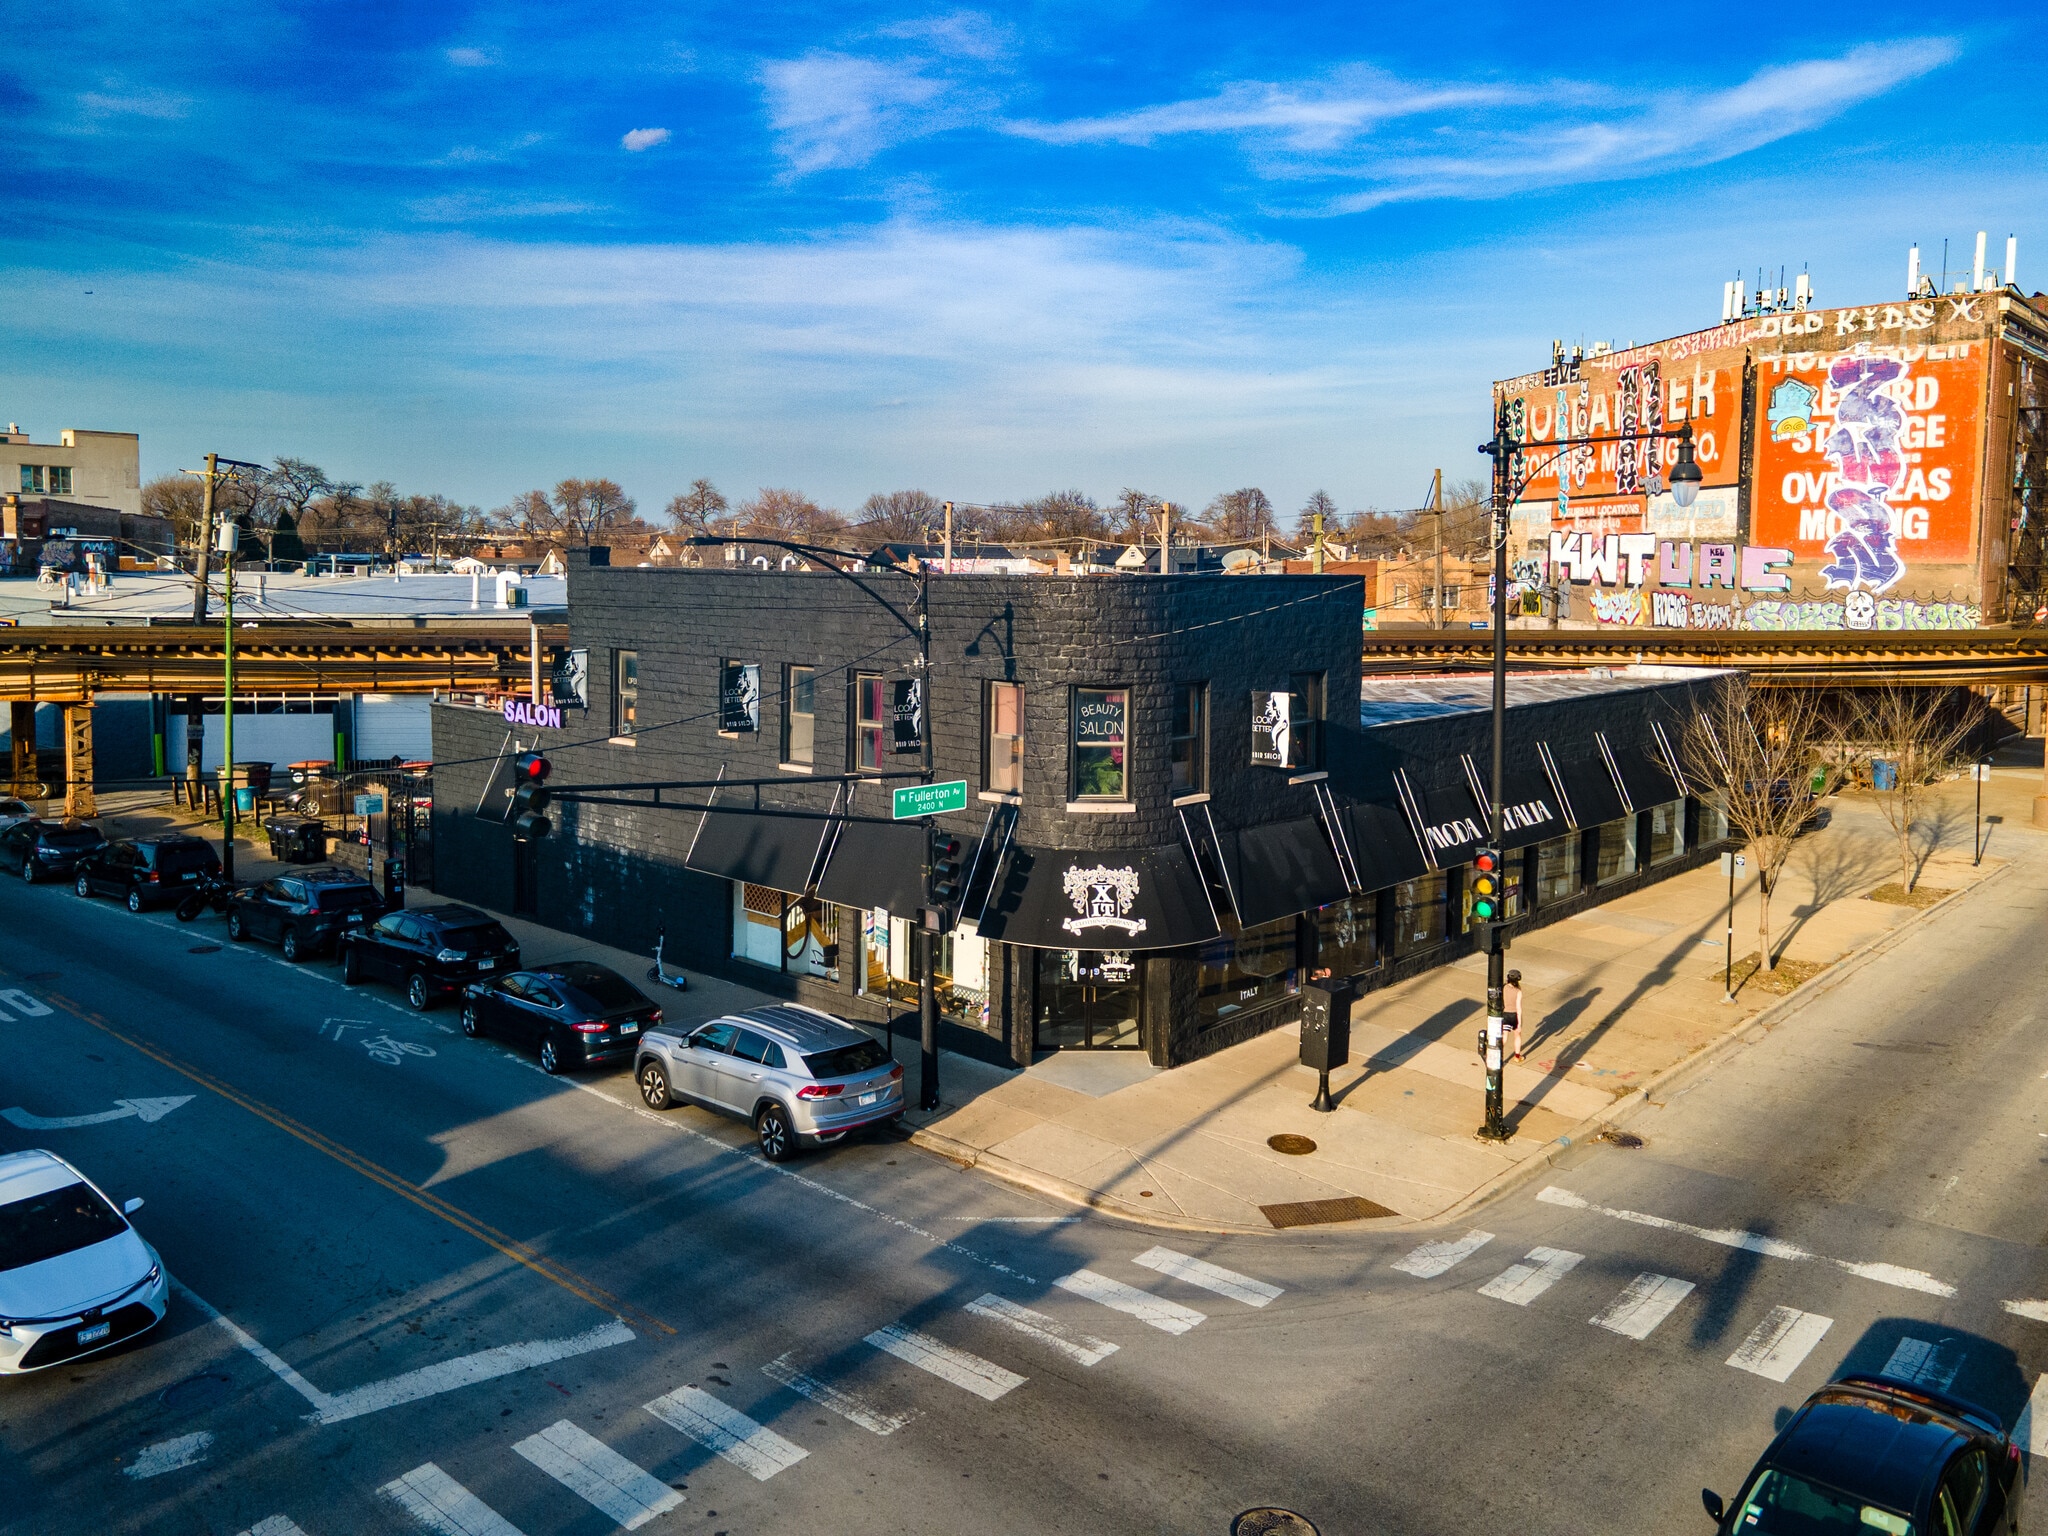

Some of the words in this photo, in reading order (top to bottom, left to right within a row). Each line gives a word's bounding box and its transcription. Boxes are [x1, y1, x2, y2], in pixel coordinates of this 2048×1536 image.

[1548, 531, 1656, 588] KWT
[503, 699, 561, 729] SALON
[1080, 703, 1122, 718] BEAUTY
[1079, 720, 1125, 736] SALON
[900, 794, 906, 803] W
[908, 788, 950, 803] Fullerton
[952, 787, 960, 796] Av
[917, 801, 935, 812] 2400
[938, 800, 944, 808] N
[1426, 817, 1482, 850] MODA
[1091, 884, 1115, 903] X
[1106, 918, 1134, 928] COMPANY
[1240, 985, 1259, 1001] ITALY
